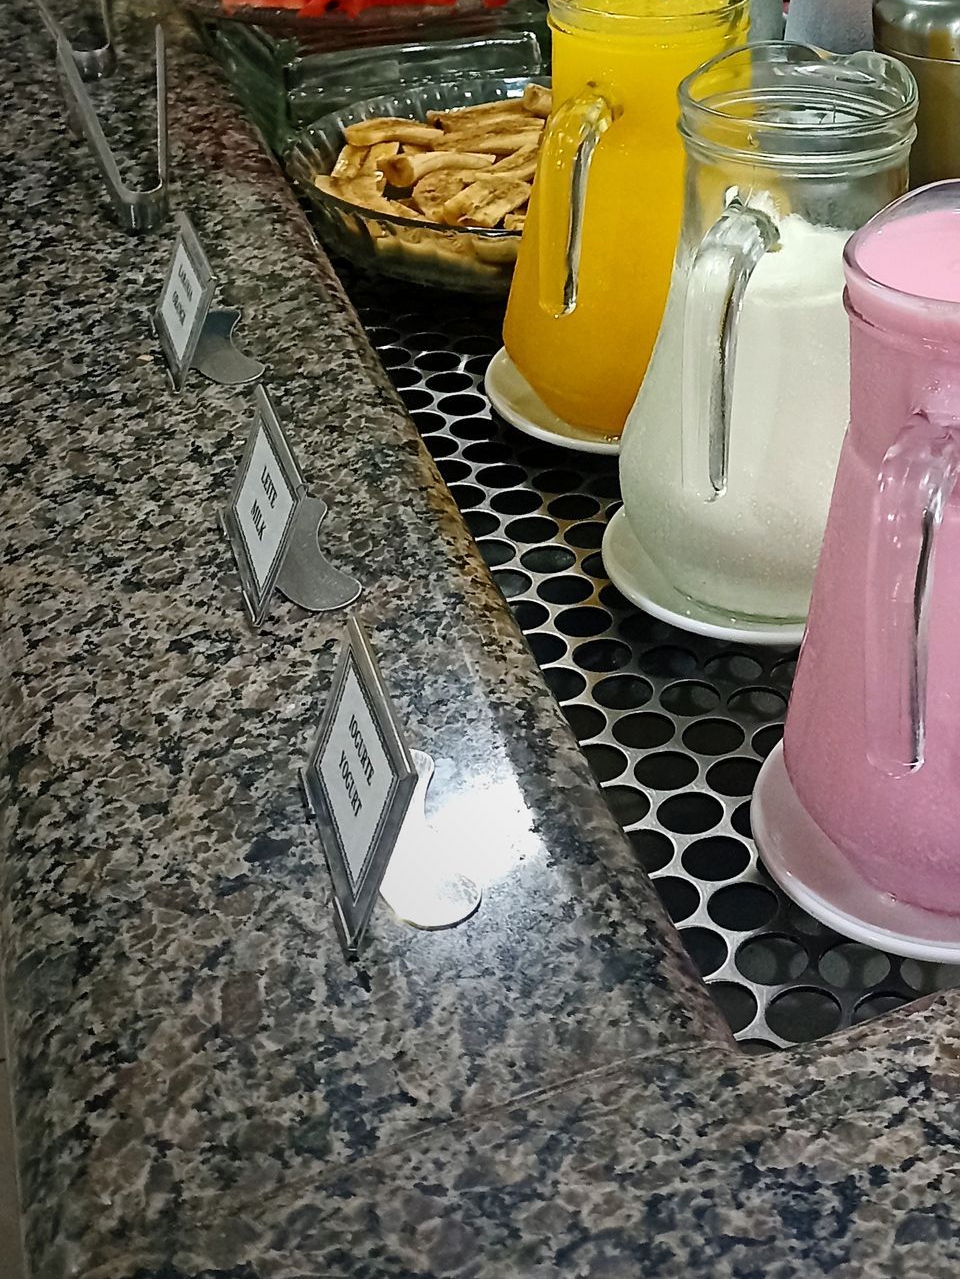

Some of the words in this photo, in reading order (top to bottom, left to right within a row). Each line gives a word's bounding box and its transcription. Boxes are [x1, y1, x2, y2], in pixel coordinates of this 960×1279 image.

[261, 465, 278, 509] LEITE
[250, 499, 267, 542] MILK
[348, 713, 375, 787] IOGURTE
[338, 750, 363, 817] YOGURT
